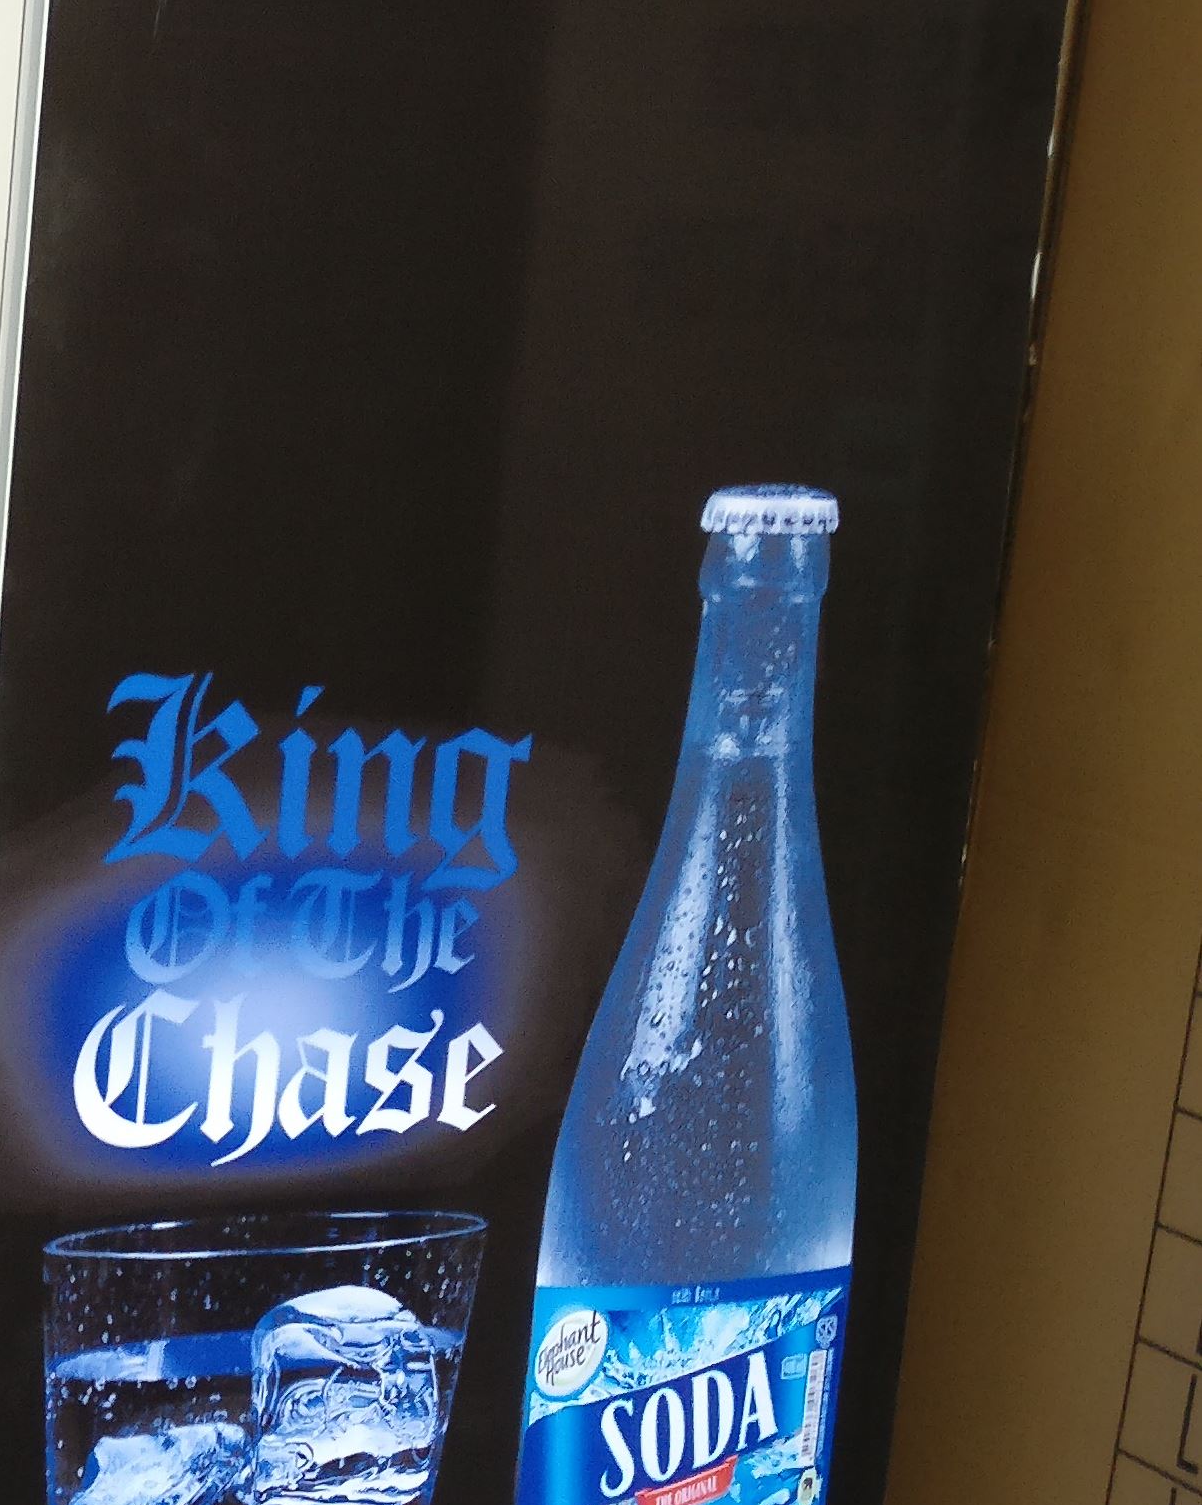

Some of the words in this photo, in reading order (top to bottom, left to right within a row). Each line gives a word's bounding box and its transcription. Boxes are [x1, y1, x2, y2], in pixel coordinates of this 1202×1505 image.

[104, 671, 534, 893] King
[124, 870, 277, 986] Of
[282, 867, 481, 994] The
[73, 985, 505, 1168] Chase
[599, 1350, 779, 1498] SODA
